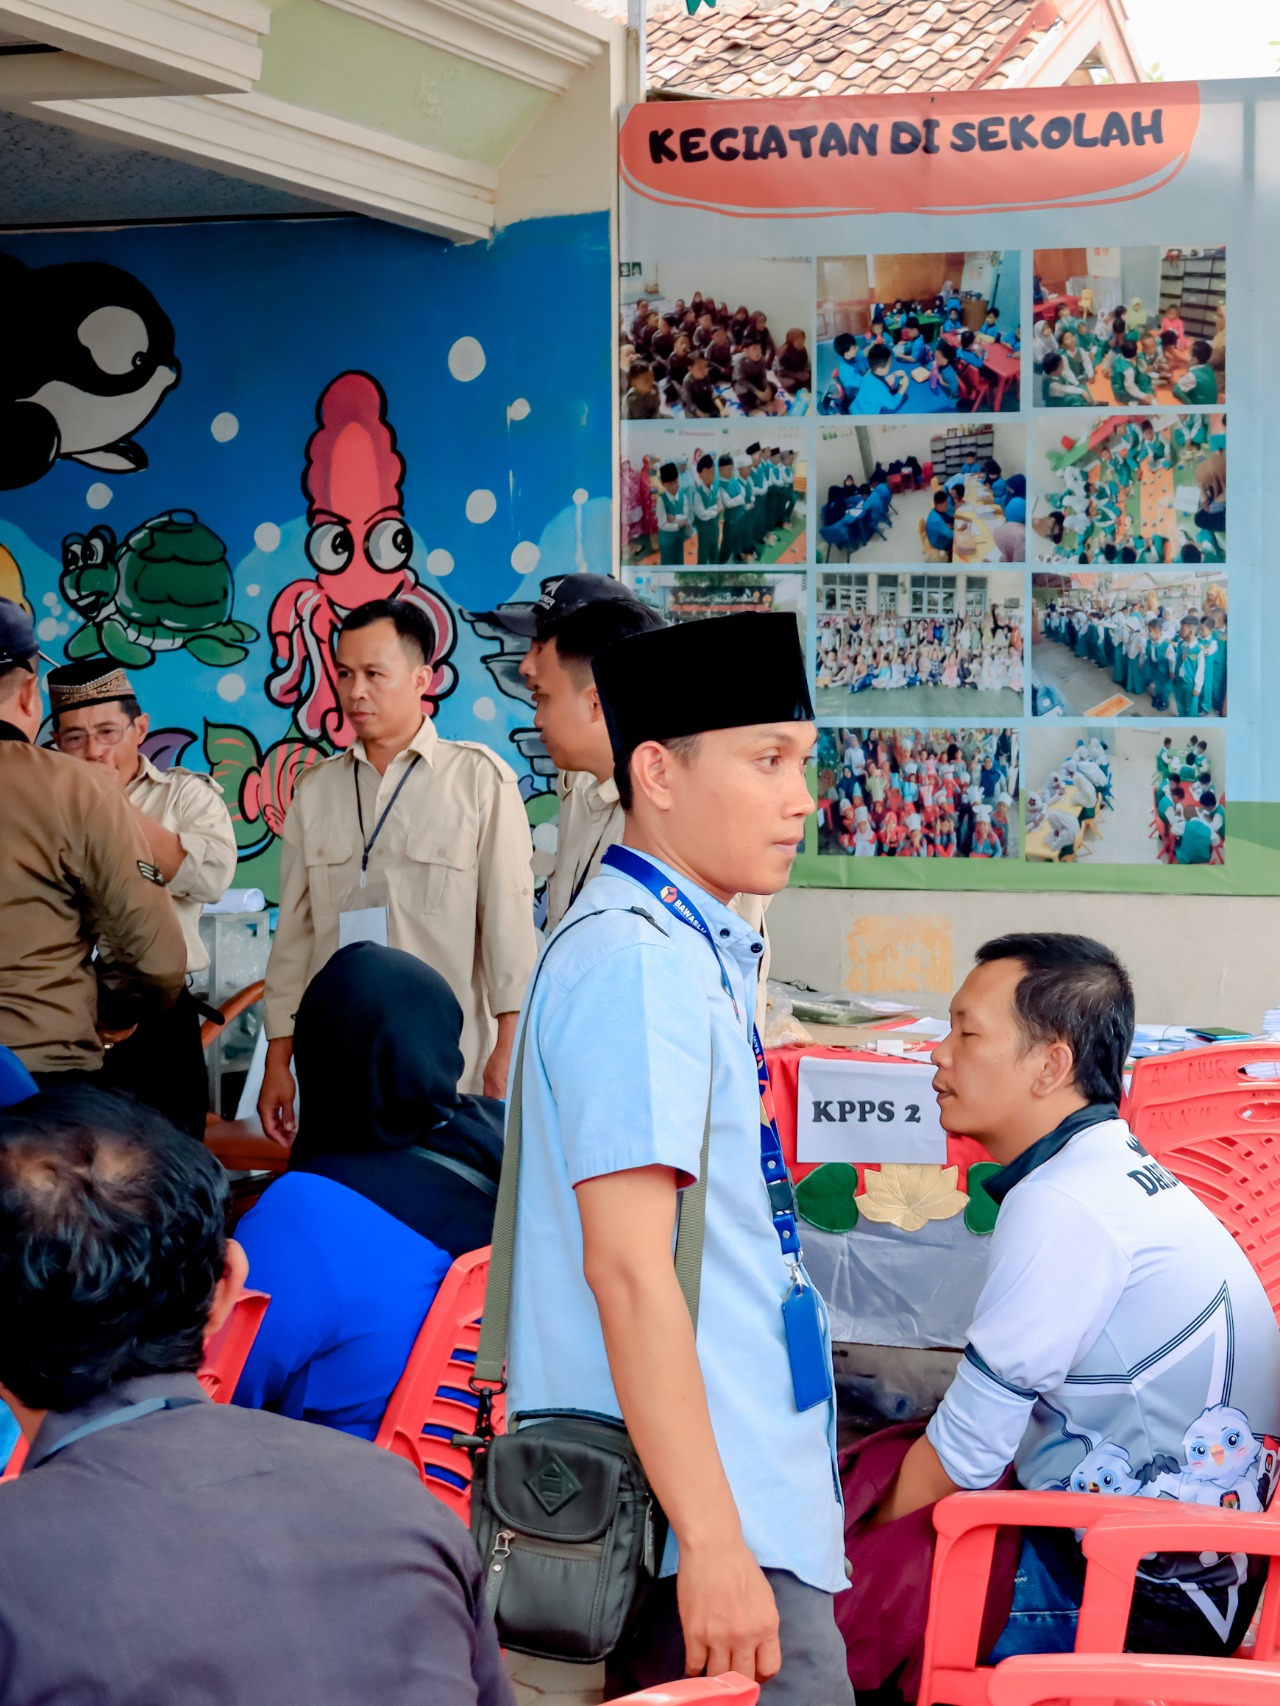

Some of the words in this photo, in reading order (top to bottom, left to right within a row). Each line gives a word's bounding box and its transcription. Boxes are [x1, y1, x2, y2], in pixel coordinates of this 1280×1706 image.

[649, 122, 878, 163] KEGIATAN
[890, 119, 940, 154] DI
[950, 109, 1163, 152] SEKOLAH
[673, 899, 707, 933] BAWASLU
[812, 1100, 895, 1123] KPPS
[904, 1104, 921, 1124] 2
